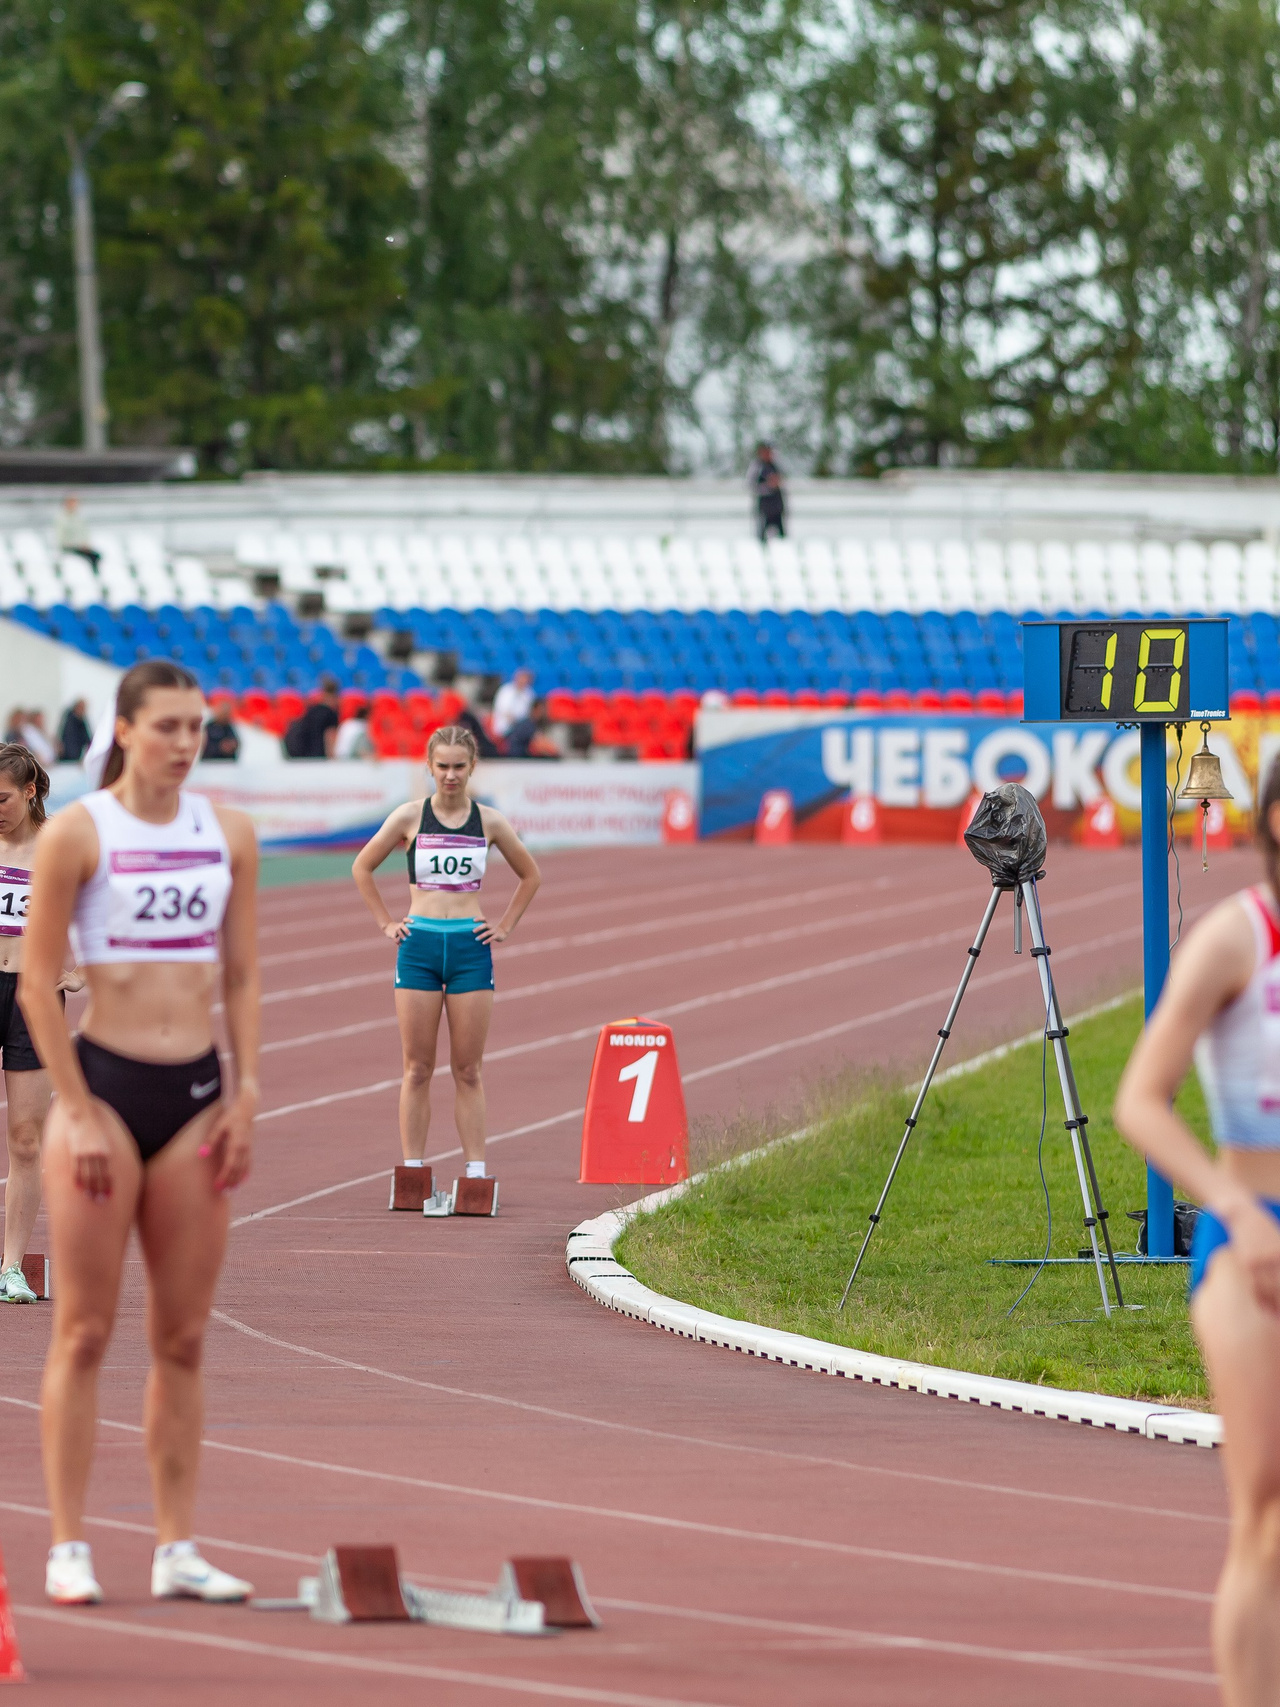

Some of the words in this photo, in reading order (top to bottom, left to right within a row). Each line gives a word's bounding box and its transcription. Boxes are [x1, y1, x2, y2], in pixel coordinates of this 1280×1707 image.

[1101, 628, 1186, 712] 10
[1190, 709, 1226, 718] TimeTronics
[429, 855, 472, 876] 105
[134, 885, 208, 920] 236
[609, 1034, 667, 1047] MONDO
[618, 1050, 660, 1123] 1
